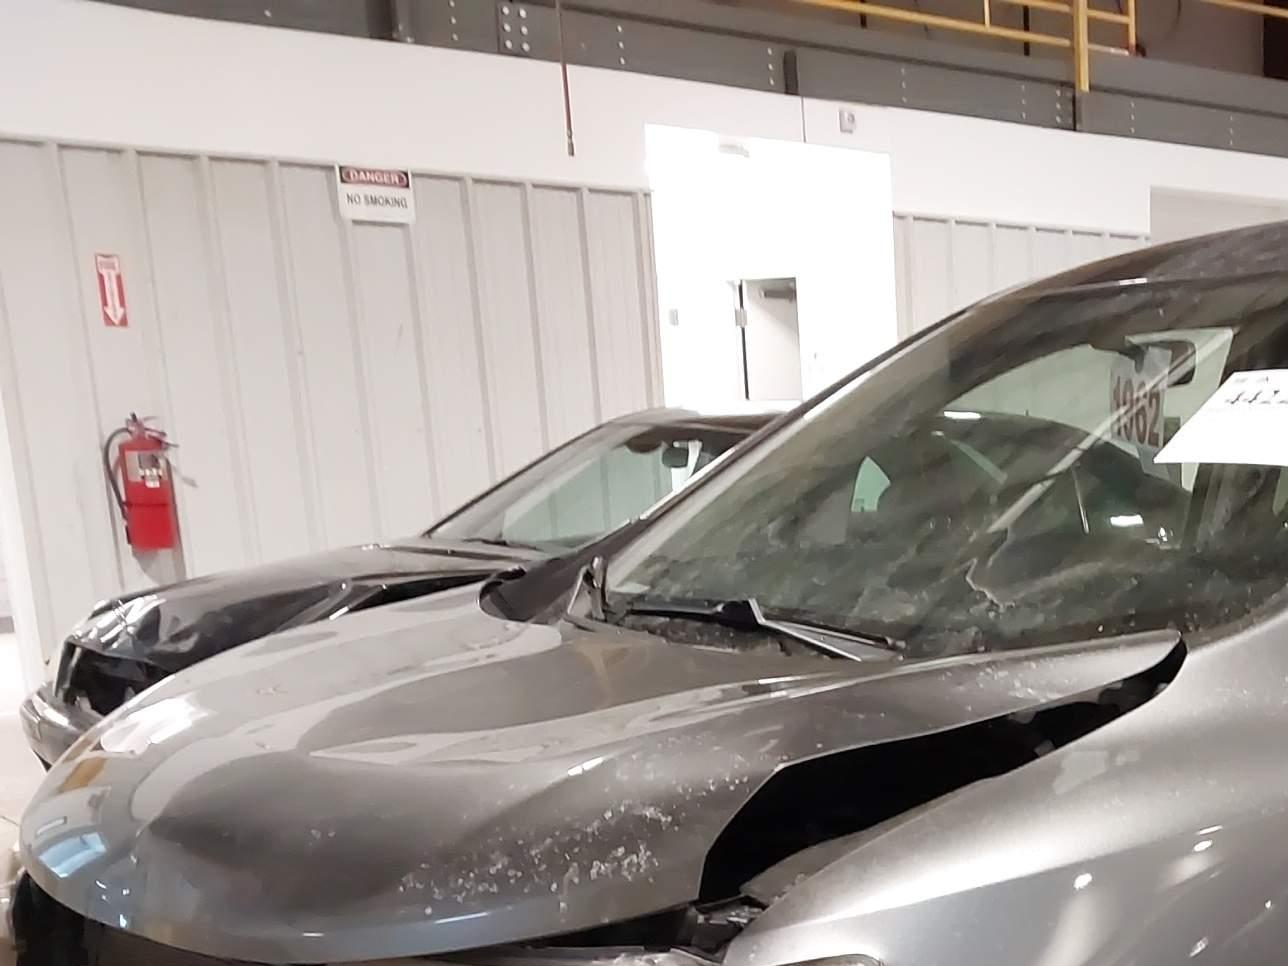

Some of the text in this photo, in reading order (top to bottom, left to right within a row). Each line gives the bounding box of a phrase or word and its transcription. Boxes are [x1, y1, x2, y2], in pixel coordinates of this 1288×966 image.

[349, 169, 400, 185] DANGER
[346, 192, 408, 209] NO SMOKING
